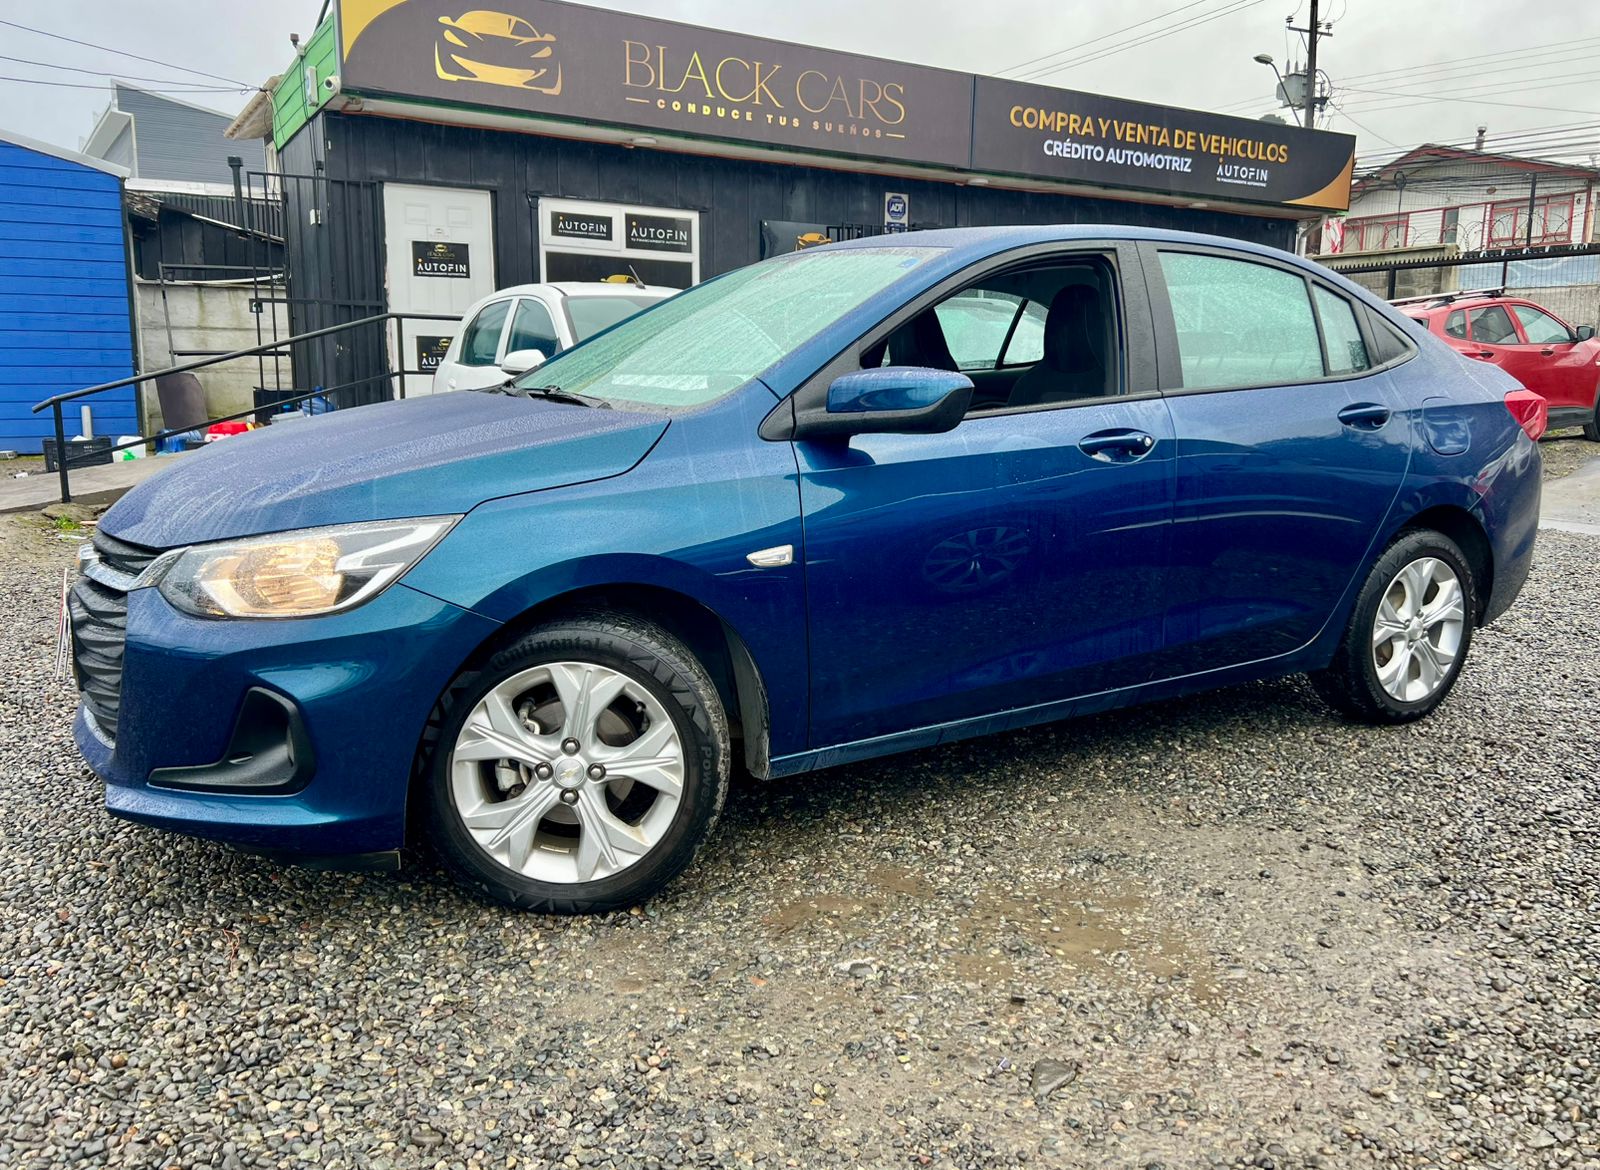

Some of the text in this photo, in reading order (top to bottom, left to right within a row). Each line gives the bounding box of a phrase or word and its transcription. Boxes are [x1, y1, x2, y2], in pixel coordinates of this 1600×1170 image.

[622, 40, 905, 125] BLACK CARS
[657, 99, 882, 138] CONDUCE TUS SUEÑOS
[1009, 105, 1288, 163] COMPRA Y VENTA DE VEHICULOS
[1043, 138, 1192, 172] CRÉDITO AUTOMOTRIZ
[1216, 163, 1268, 182] AUTOFIN
[558, 220, 607, 233] AUTOFIN
[631, 226, 688, 241] AUTOFIN
[417, 262, 467, 273] AUTOFIN
